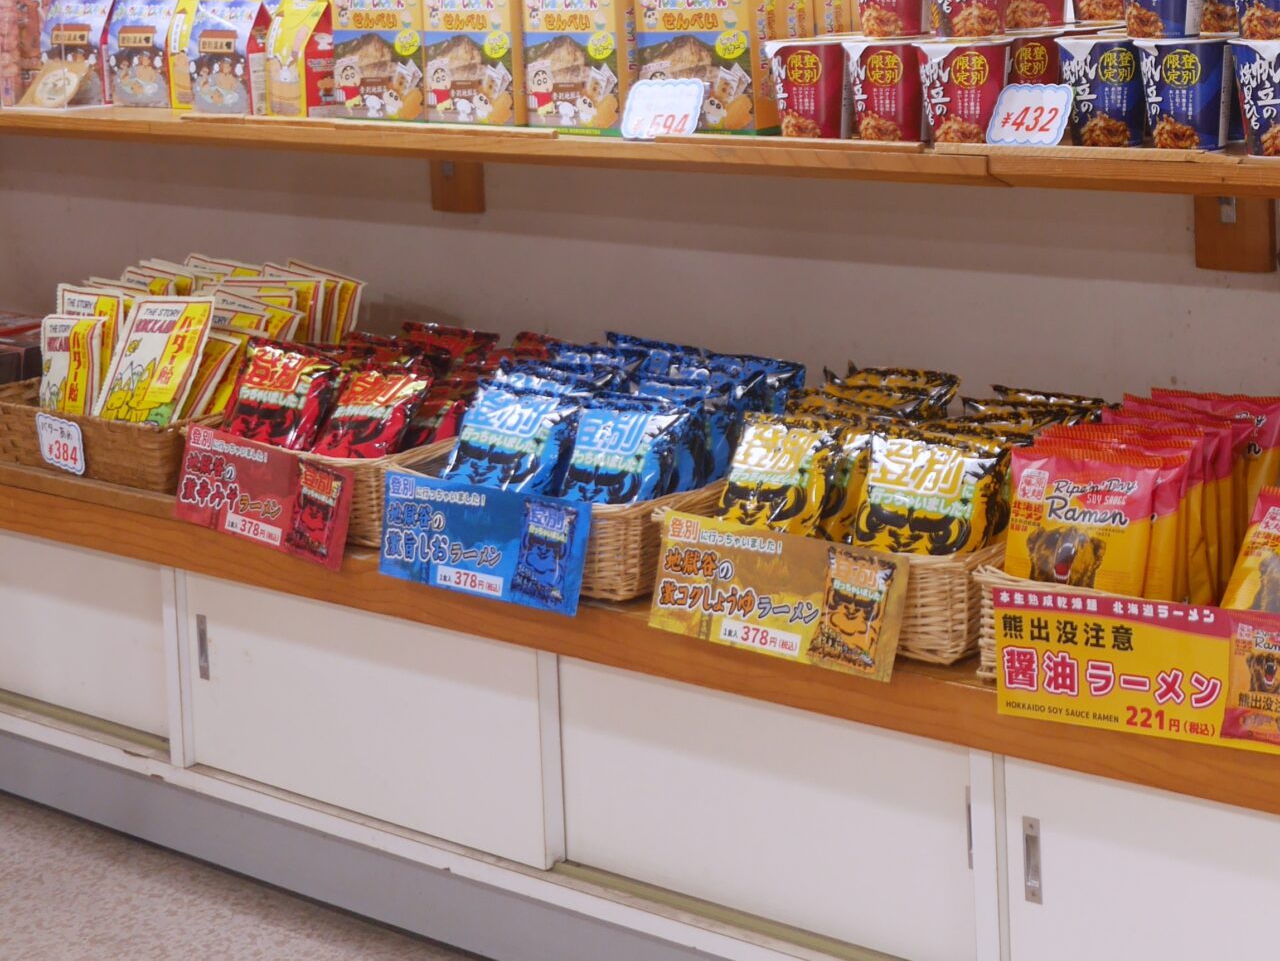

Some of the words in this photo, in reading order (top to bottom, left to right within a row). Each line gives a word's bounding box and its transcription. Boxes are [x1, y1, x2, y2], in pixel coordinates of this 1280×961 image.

[352, 13, 397, 30] せんべい
[443, 13, 487, 30] せんべい
[544, 13, 591, 30] せんべい
[663, 13, 718, 30] せんべい
[1002, 106, 1058, 132] ¥432
[144, 308, 155, 317] THE
[157, 309, 180, 319] STORY
[155, 316, 198, 386] バター飴
[191, 429, 213, 447] 登別
[48, 440, 78, 465] ¥384
[391, 476, 414, 498] 登別
[1087, 494, 1102, 504] SOY
[1104, 495, 1127, 505] SAUCE
[870, 486, 973, 520] 行っちゃいました!
[1046, 496, 1128, 525] Ramen
[387, 504, 444, 532] 地獄谷の
[671, 518, 699, 541] 登別
[701, 531, 783, 554] に行っちゃいました!
[385, 532, 502, 567] 激旨しおラーメン
[665, 551, 733, 580] 地獄谷の
[454, 571, 501, 593] 378円(税込)
[660, 582, 820, 624] 激コクしょうゆラーメン
[1113, 601, 1215, 623] 北海道ラーメン
[741, 625, 798, 652] 378円(税込)
[1002, 613, 1134, 652] 熊出没注意
[1003, 646, 1222, 708] 醤油ラーメン
[1006, 700, 1046, 713] HOKKAIDO
[1048, 705, 1062, 715] SOY
[1065, 708, 1090, 720] SAUCE
[1093, 712, 1119, 724] RAMEN
[1126, 706, 1217, 737] 221円(税込)
